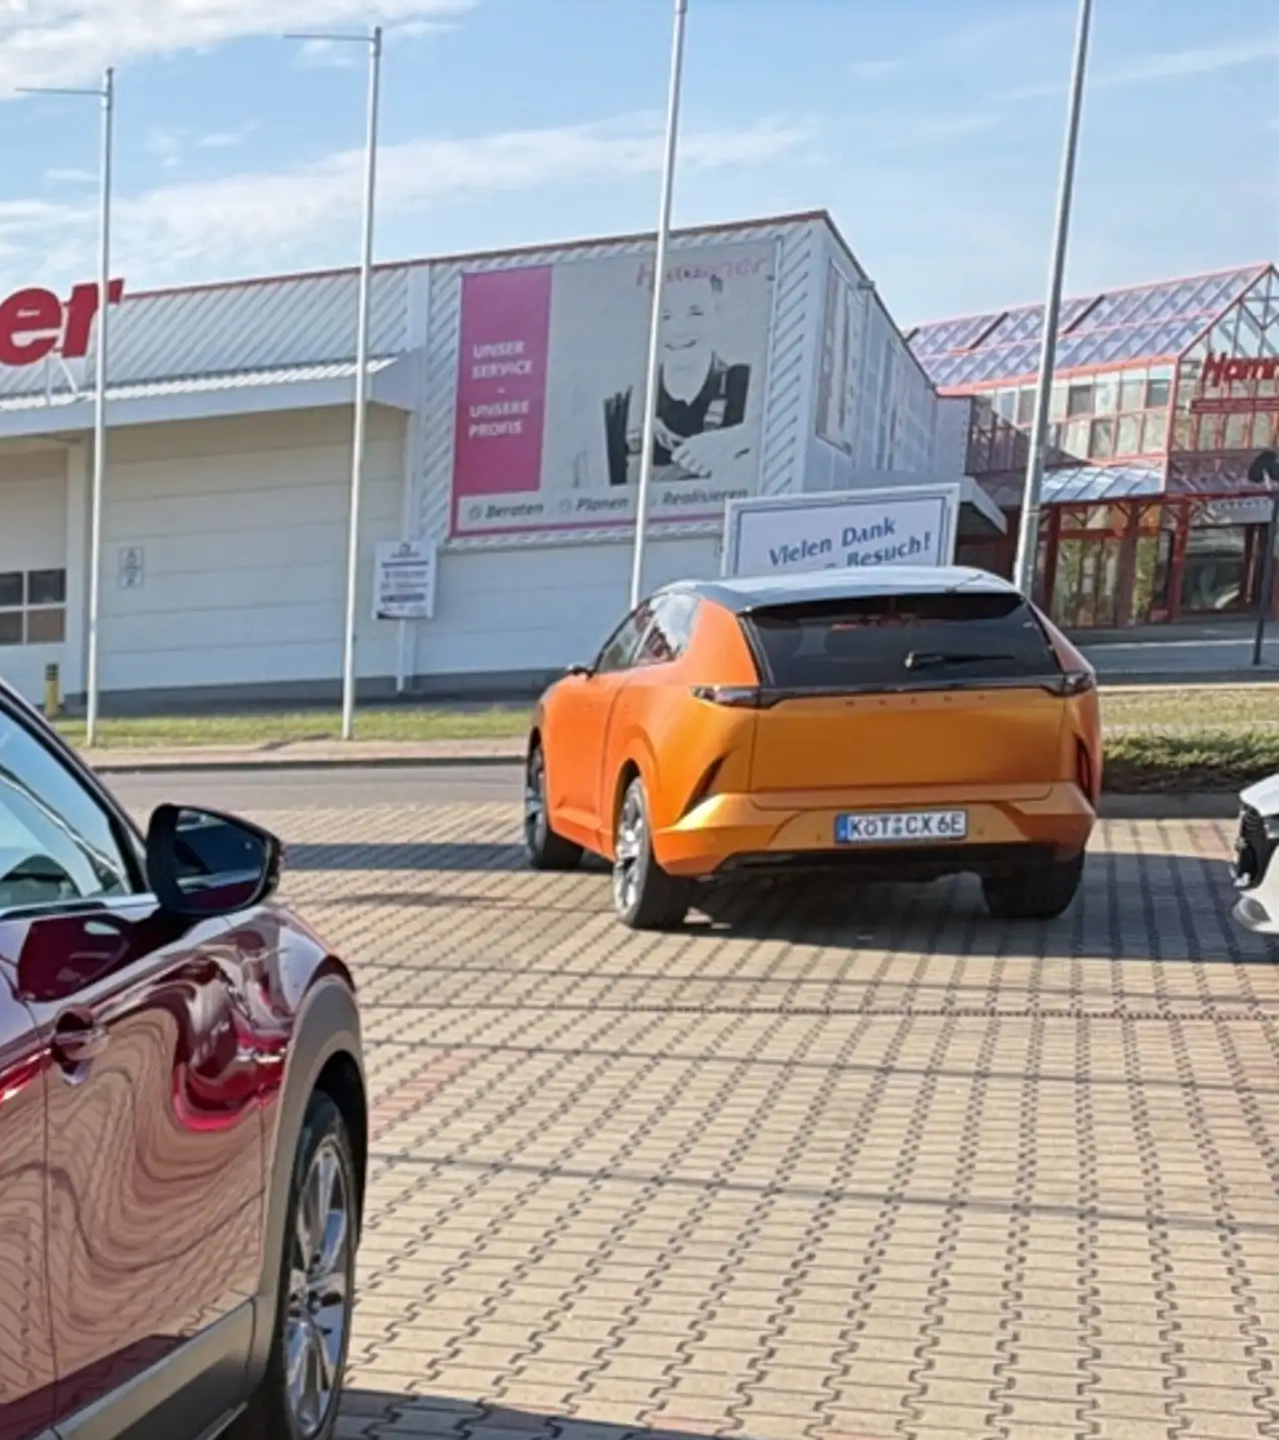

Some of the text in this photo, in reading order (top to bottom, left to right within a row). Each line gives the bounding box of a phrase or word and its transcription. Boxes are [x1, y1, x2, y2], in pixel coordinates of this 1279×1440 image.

[473, 340, 525, 359] UNSER
[471, 360, 532, 379] SERVICE
[469, 400, 529, 418] UNSERE
[468, 421, 522, 440] PROFIS
[485, 502, 544, 519] Beraten
[576, 498, 629, 512] Planen
[769, 517, 897, 566] Vielen Dank
[850, 812, 963, 837] KÖT CX 6E
